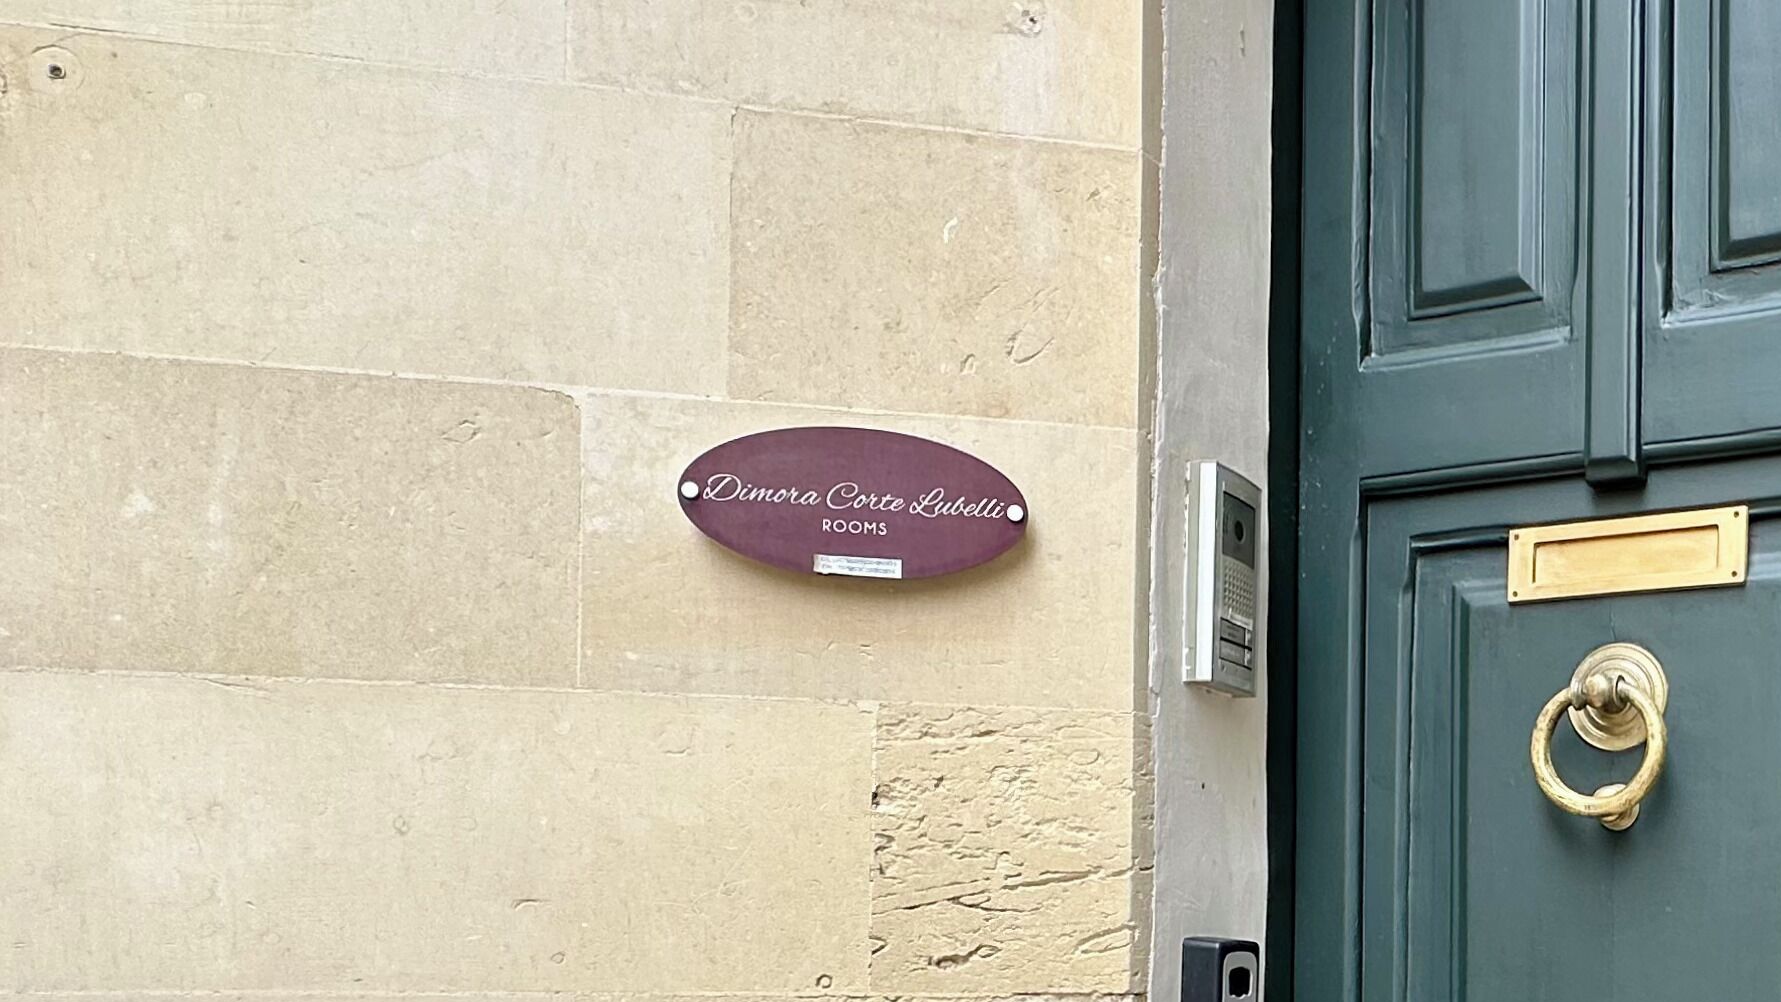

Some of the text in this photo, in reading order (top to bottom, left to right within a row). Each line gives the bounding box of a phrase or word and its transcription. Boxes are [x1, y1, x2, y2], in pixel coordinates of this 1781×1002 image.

[702, 473, 1005, 520] Dimora Corte Lubelli
[822, 519, 888, 536] ROOMS
